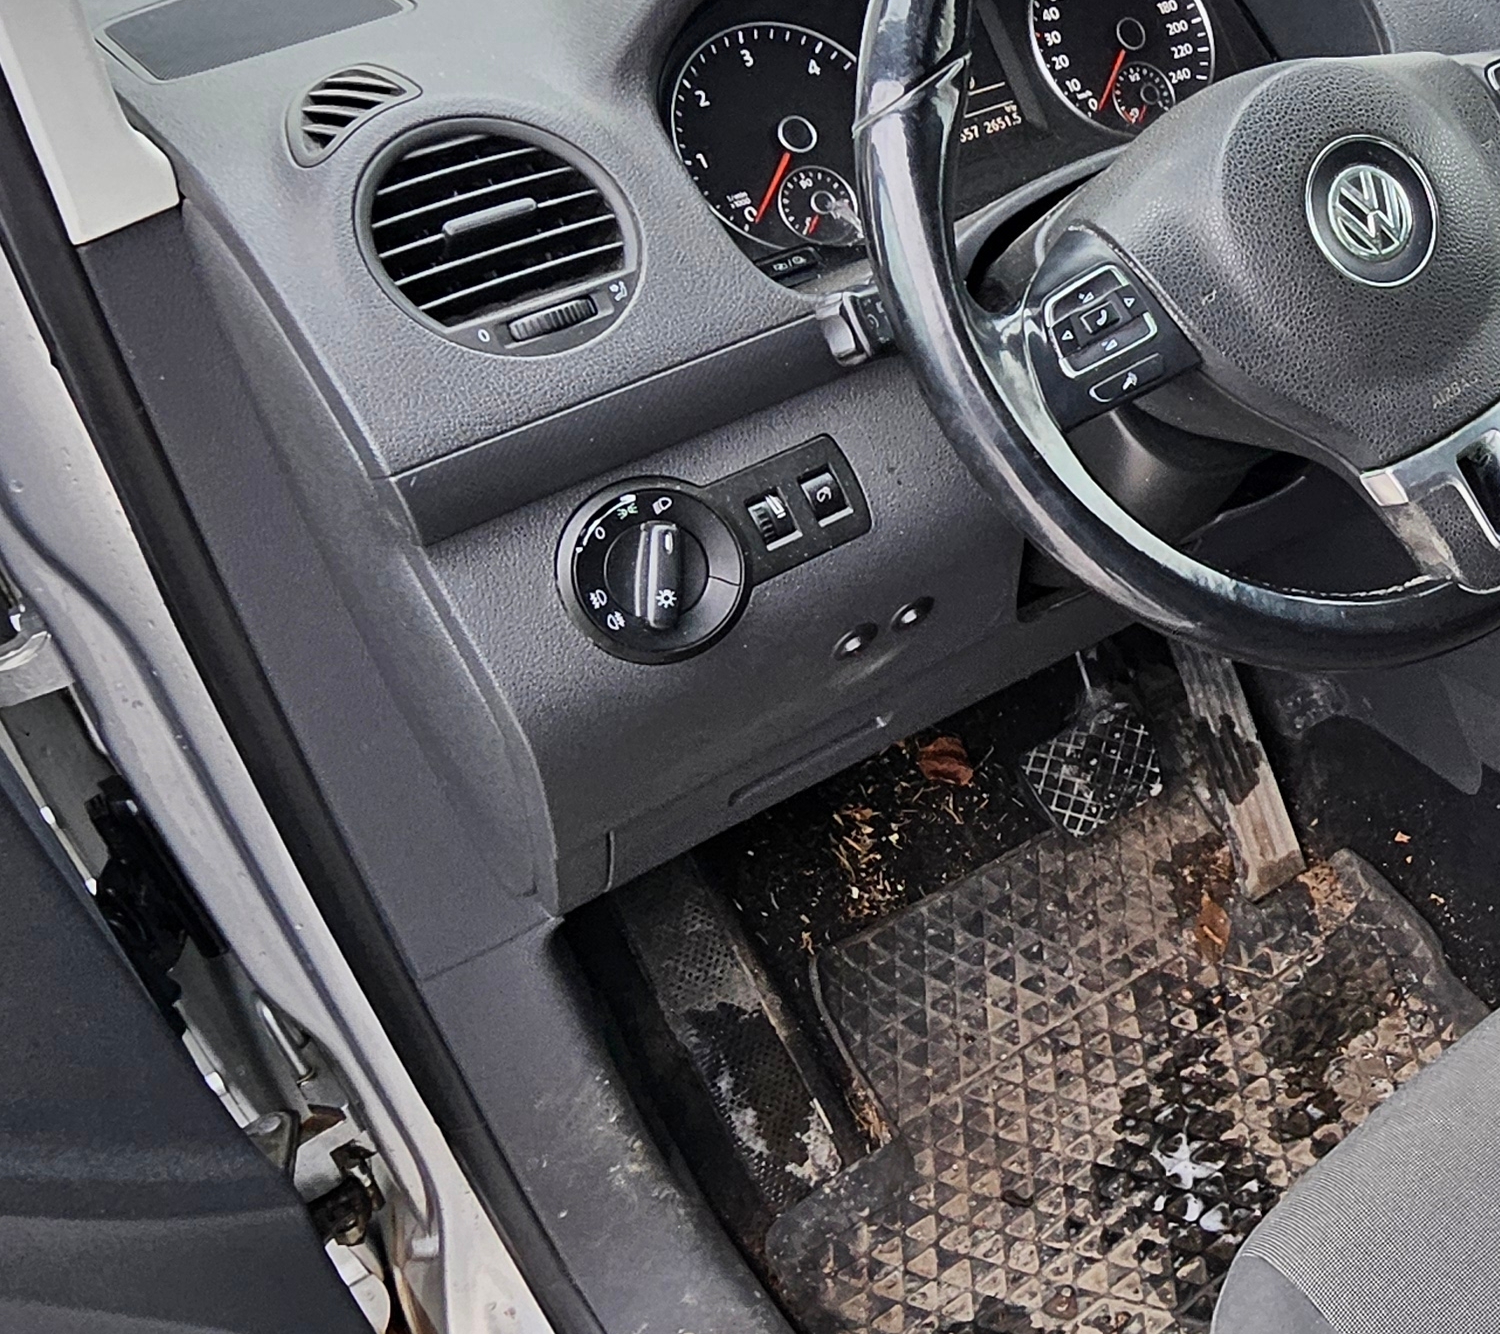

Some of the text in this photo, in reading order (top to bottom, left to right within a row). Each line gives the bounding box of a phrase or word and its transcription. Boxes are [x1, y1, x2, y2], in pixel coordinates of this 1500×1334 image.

[1042, 6, 1060, 22] 40
[1156, 0, 1178, 15] 180
[1165, 19, 1189, 36] 200
[1044, 30, 1062, 47] 30
[740, 49, 754, 68] 3
[1170, 43, 1193, 59] 220
[808, 59, 821, 76] 4
[1051, 54, 1070, 70] 20
[1168, 67, 1191, 84] 240
[1065, 77, 1082, 93] 10
[694, 90, 711, 107] 2
[1088, 97, 1098, 111] 0
[983, 112, 1022, 134] 2651.5
[696, 153, 708, 169] 1
